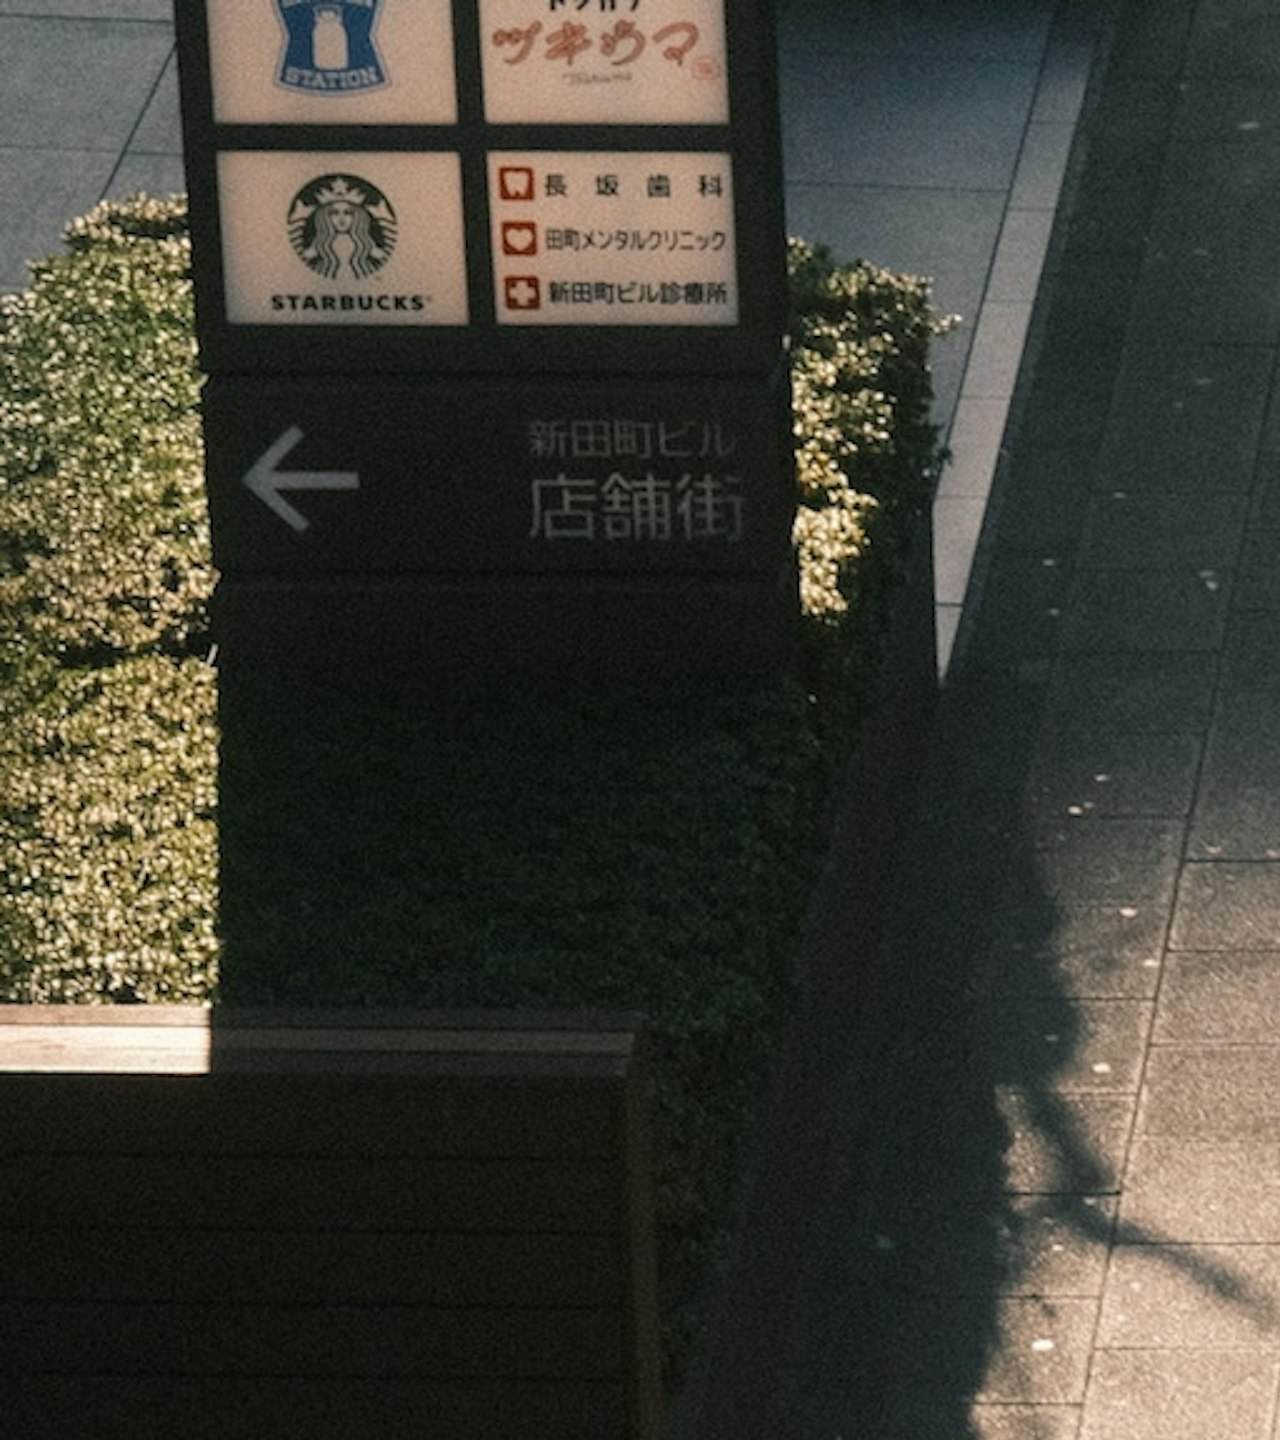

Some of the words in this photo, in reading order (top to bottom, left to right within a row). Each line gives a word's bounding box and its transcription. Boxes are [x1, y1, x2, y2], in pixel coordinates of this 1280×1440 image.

[285, 66, 379, 89] STATION
[544, 173, 723, 198] 長坂歯科
[545, 228, 726, 252] 田町メンタルクリニック
[270, 294, 426, 311] STARBUCKS
[549, 281, 728, 305] 新田町ビル診療所
[528, 418, 737, 459] 新田町ビル
[529, 471, 744, 542] 店舗街
